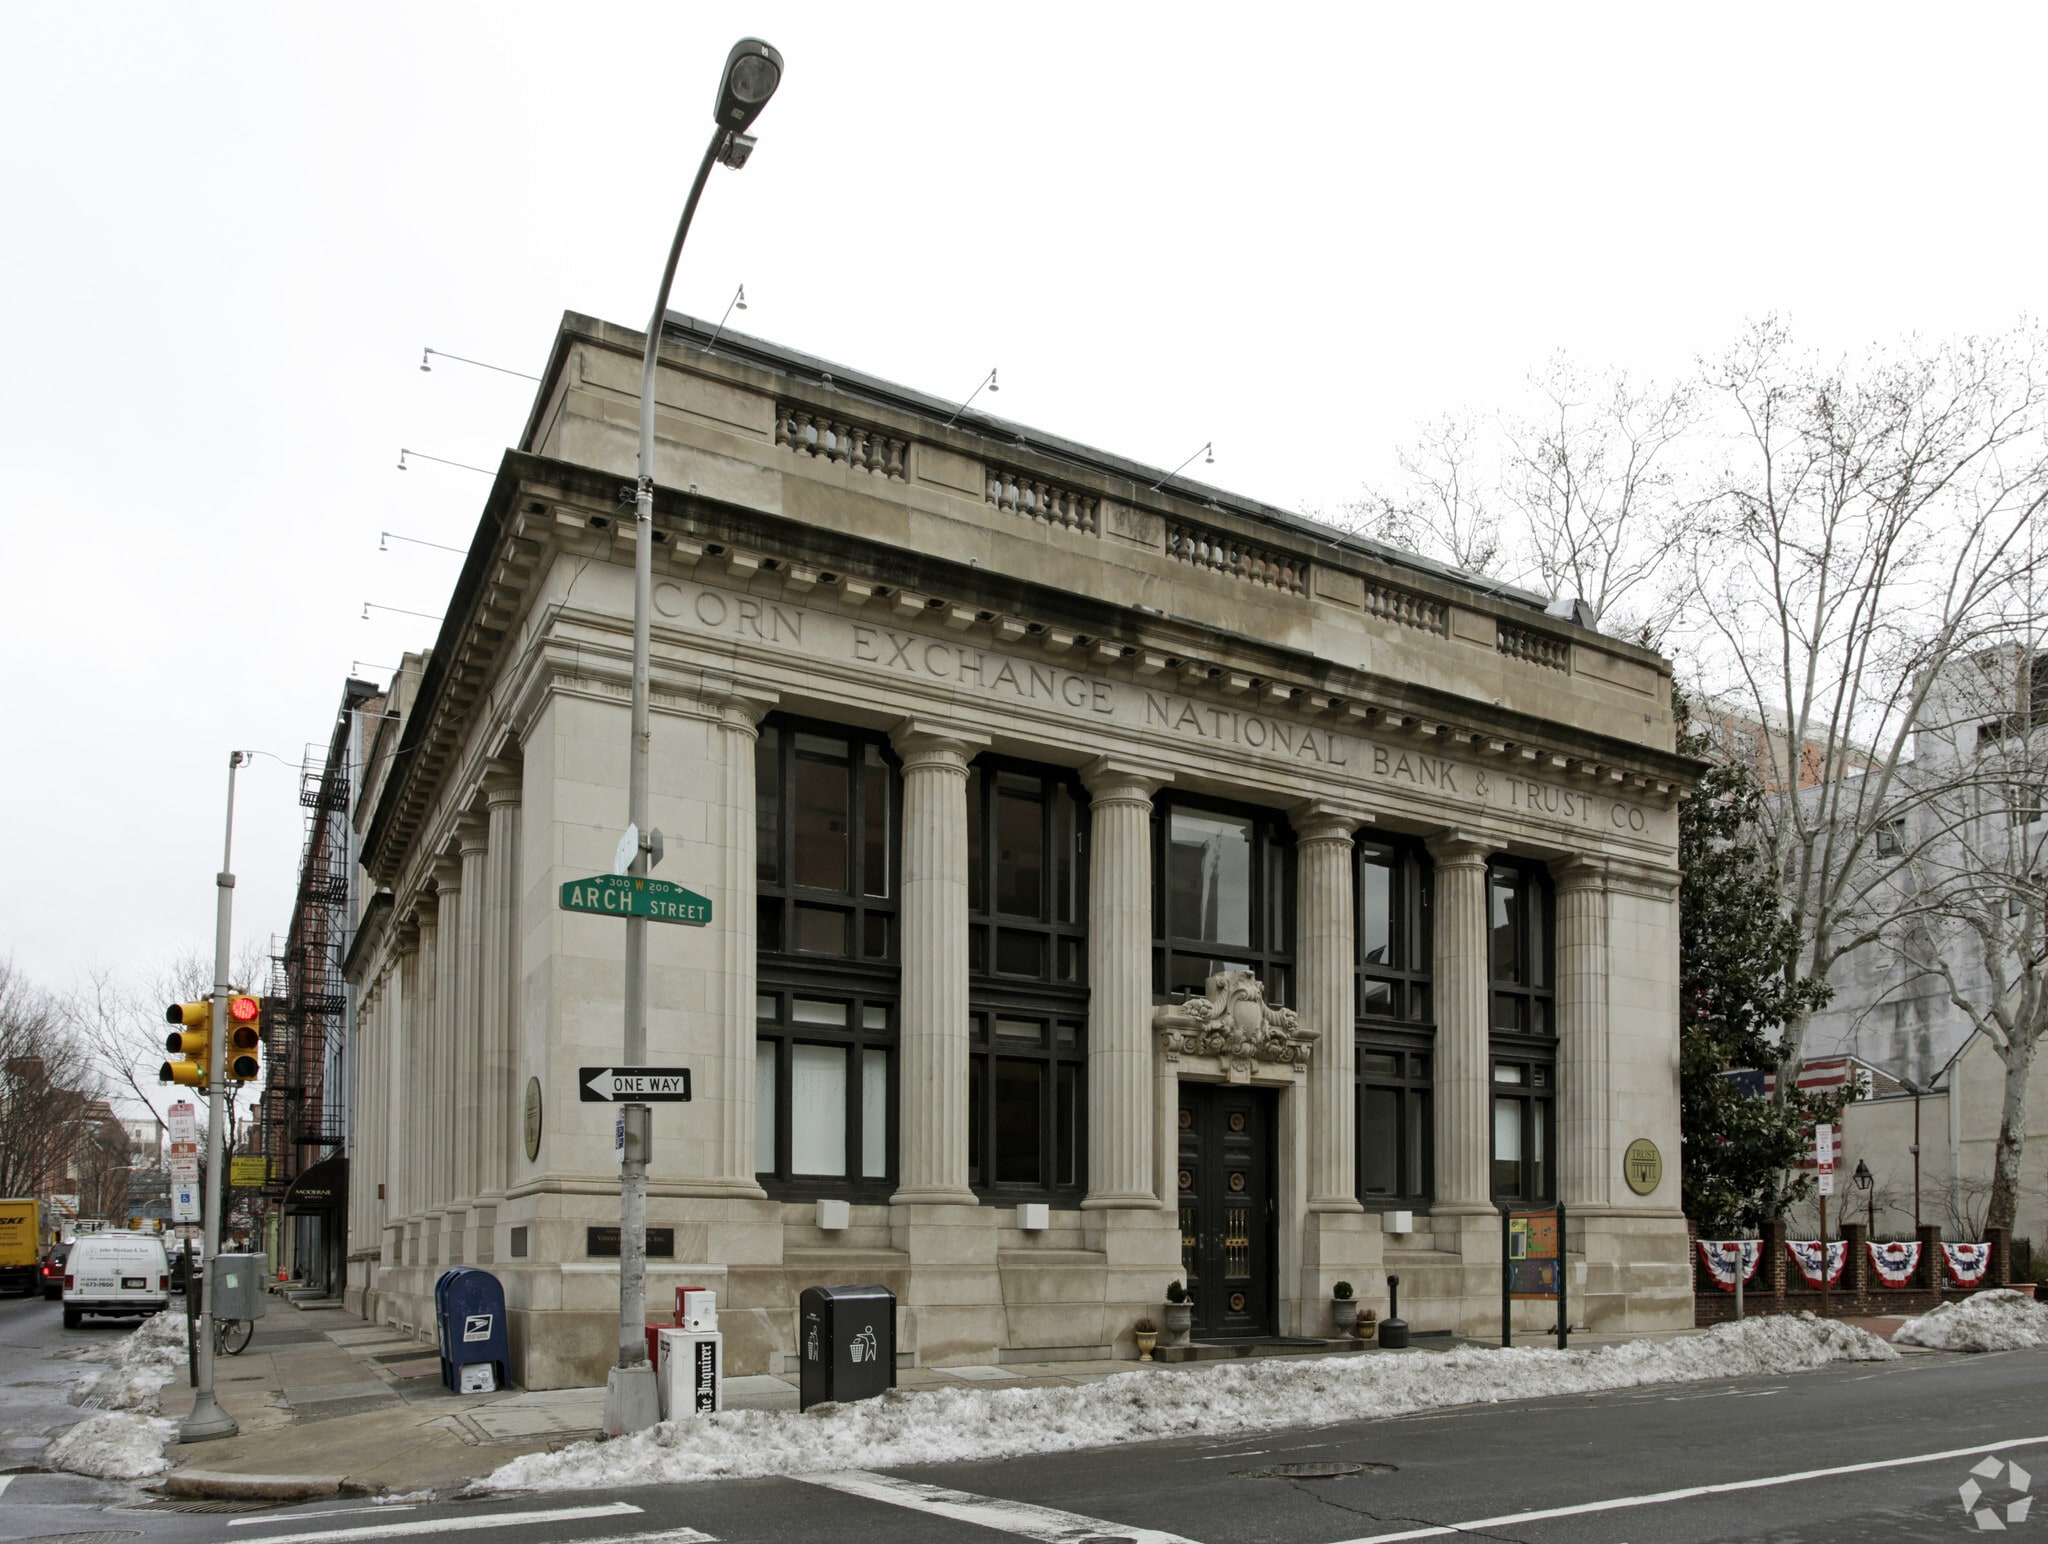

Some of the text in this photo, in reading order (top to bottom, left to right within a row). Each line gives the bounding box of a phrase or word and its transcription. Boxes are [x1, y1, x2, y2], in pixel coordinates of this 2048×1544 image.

[653, 581, 1650, 834] CORN EXCHANGE NATIONAL BANK & TRUST CO.
[609, 878, 670, 893] 300 W 200
[571, 886, 705, 920] ARCH STREET
[613, 1077, 681, 1092] ONE WAY
[174, 1127, 191, 1135] TIME
[1631, 1149, 1657, 1159] TRUST
[698, 1343, 715, 1413] he Inquirer
